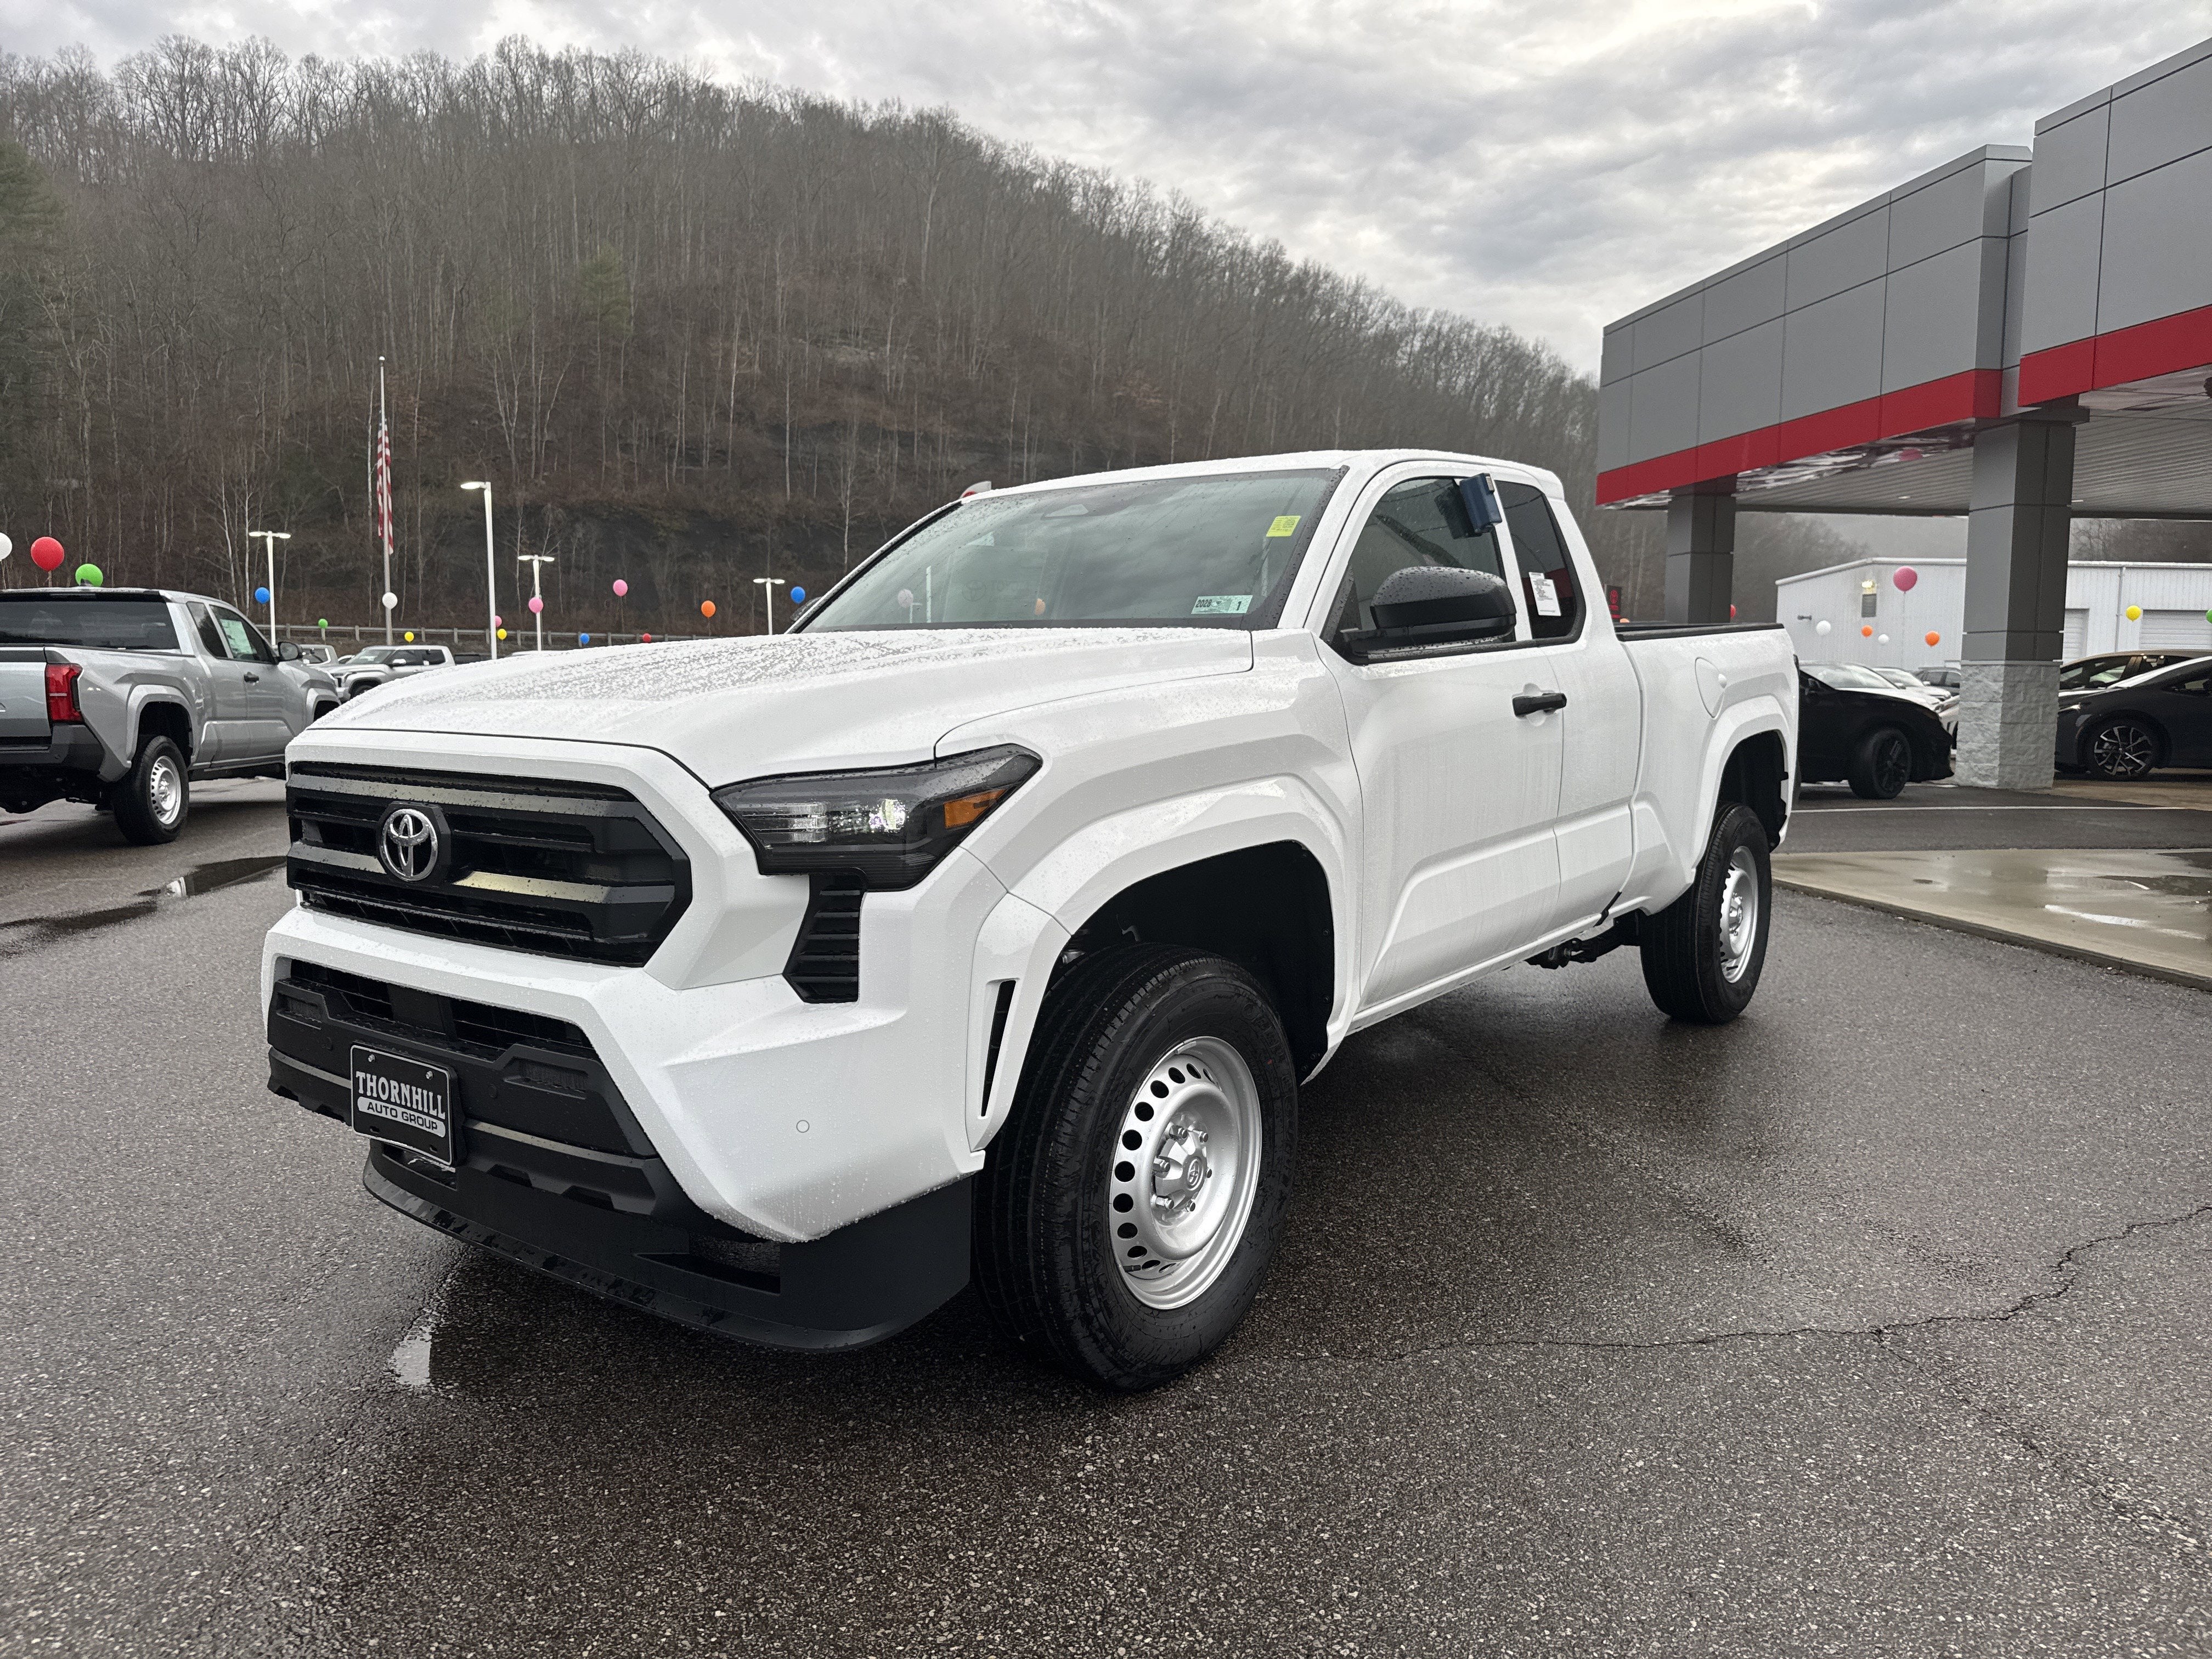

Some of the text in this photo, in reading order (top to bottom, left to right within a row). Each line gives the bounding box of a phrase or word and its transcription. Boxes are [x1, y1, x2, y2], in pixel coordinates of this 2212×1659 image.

[1195, 599, 1242, 611] 2028 1
[356, 1071, 445, 1120] THORNHILL
[367, 1102, 438, 1131] AUTO GROUP
